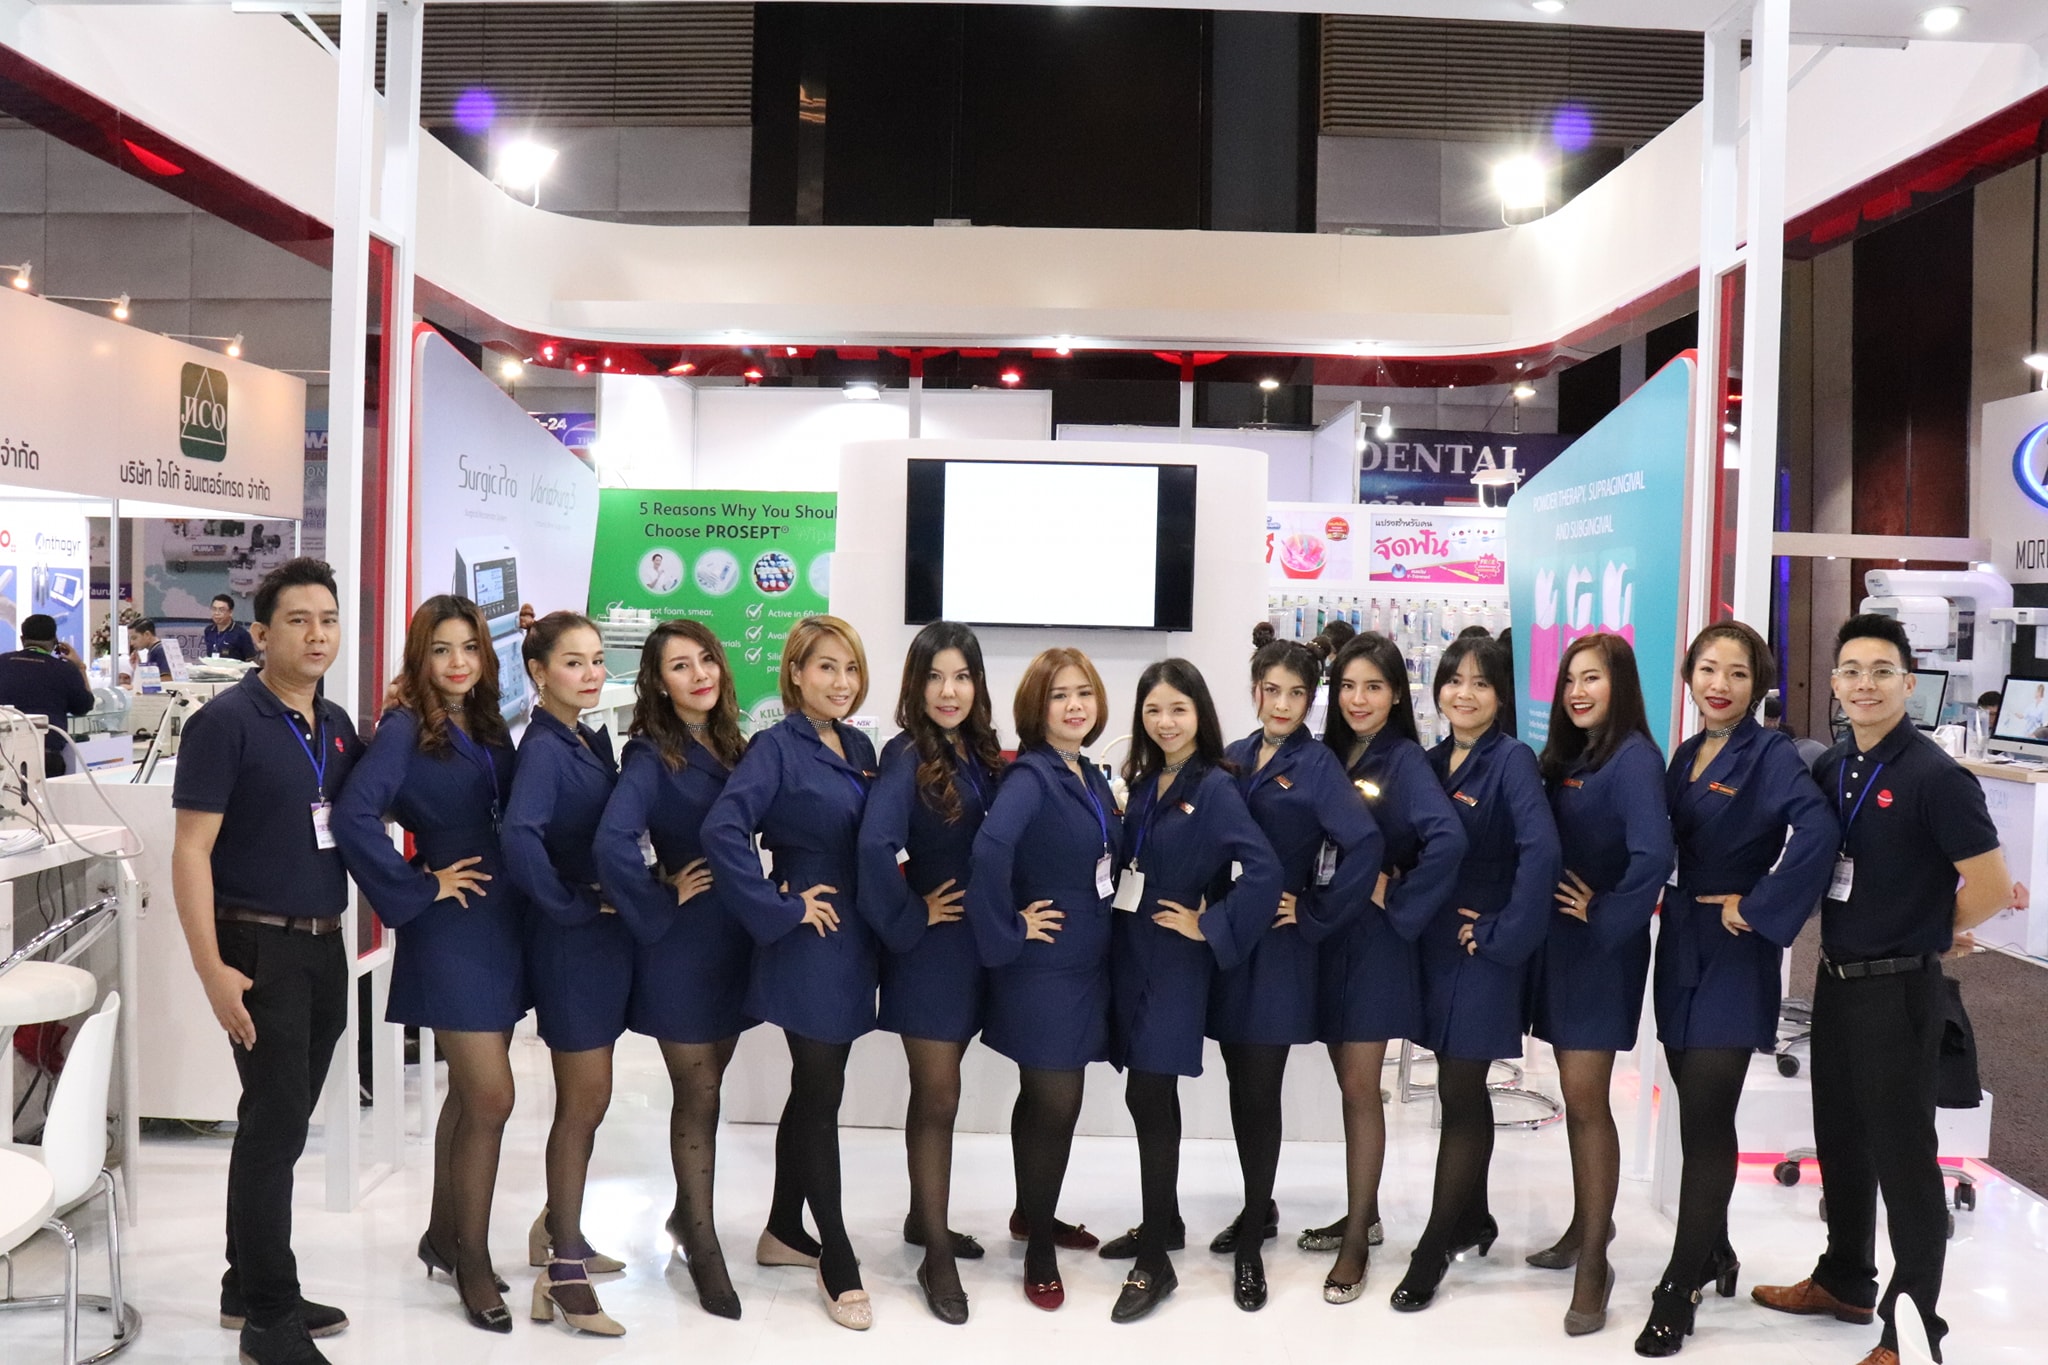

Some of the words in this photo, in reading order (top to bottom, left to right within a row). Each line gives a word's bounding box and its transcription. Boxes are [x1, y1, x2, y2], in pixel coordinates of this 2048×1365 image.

[180, 395, 226, 432] JICO
[1, 438, 39, 470] จำกัด
[1360, 441, 1526, 476] DENTAL
[120, 459, 152, 486] บริษัท
[185, 470, 244, 498] อินเตอร์เทรด
[248, 478, 271, 501] จำกัด
[1588, 470, 1645, 501] SUPRAGINGIVAL
[639, 502, 648, 515] 5
[653, 502, 717, 516] Reasons
[721, 503, 757, 521] Why
[762, 504, 790, 518] You
[795, 505, 837, 519] Shoul
[644, 523, 701, 538] Choose
[1570, 514, 1614, 539] SUBGINGIVAL
[1373, 529, 1450, 560] จัดฟัน
[2015, 539, 2048, 570] MOR
[663, 606, 686, 616] foam,
[688, 608, 714, 617] smear,
[767, 609, 792, 618] Active
[794, 609, 802, 617] in
[803, 609, 814, 617] 60
[721, 640, 742, 648] erials
[767, 631, 788, 639] Avail
[760, 707, 785, 718] KILL
